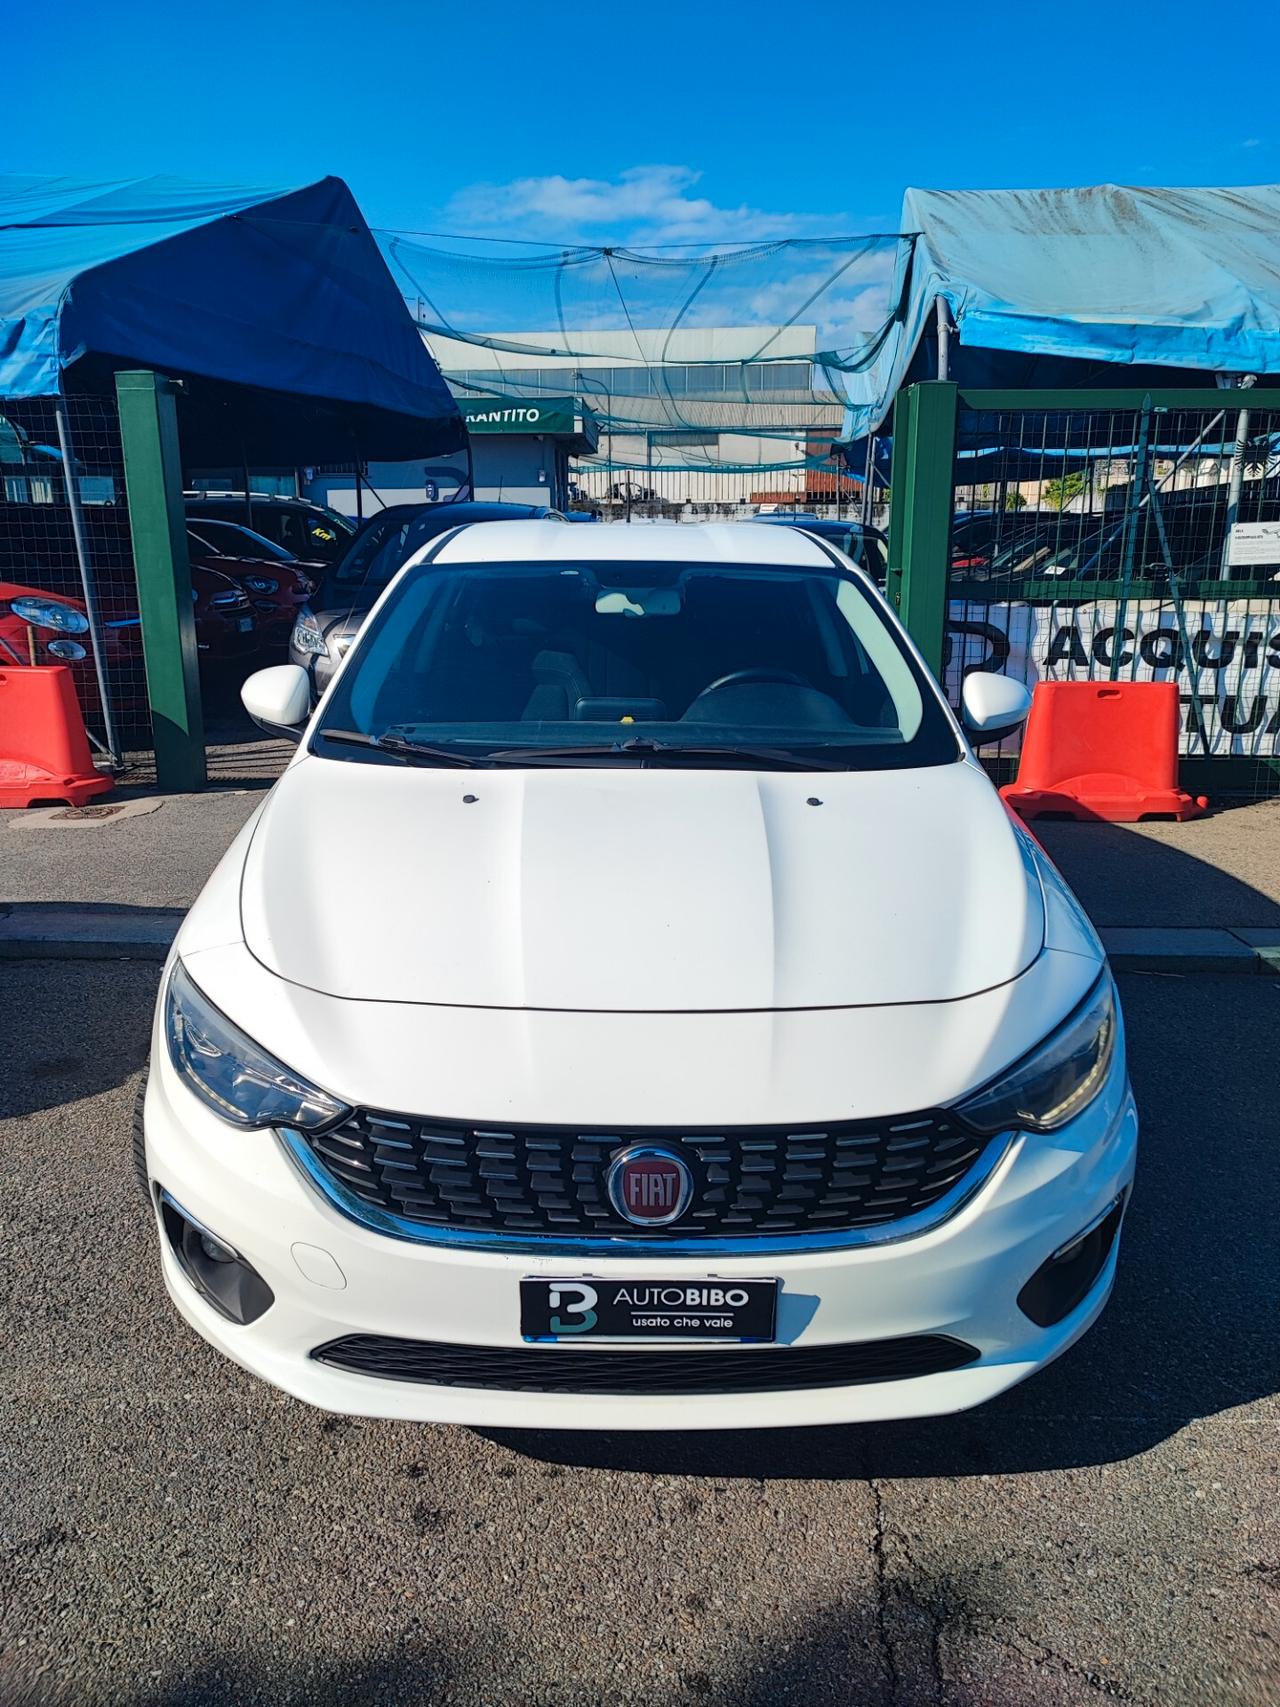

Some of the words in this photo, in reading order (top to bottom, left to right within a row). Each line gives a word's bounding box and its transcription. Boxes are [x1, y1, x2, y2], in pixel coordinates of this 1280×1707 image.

[629, 1173, 677, 1207] FIAT
[612, 1287, 750, 1308] AUTOBIBO
[632, 1317, 670, 1328] usato
[674, 1317, 700, 1328] che
[704, 1317, 733, 1329] vale
